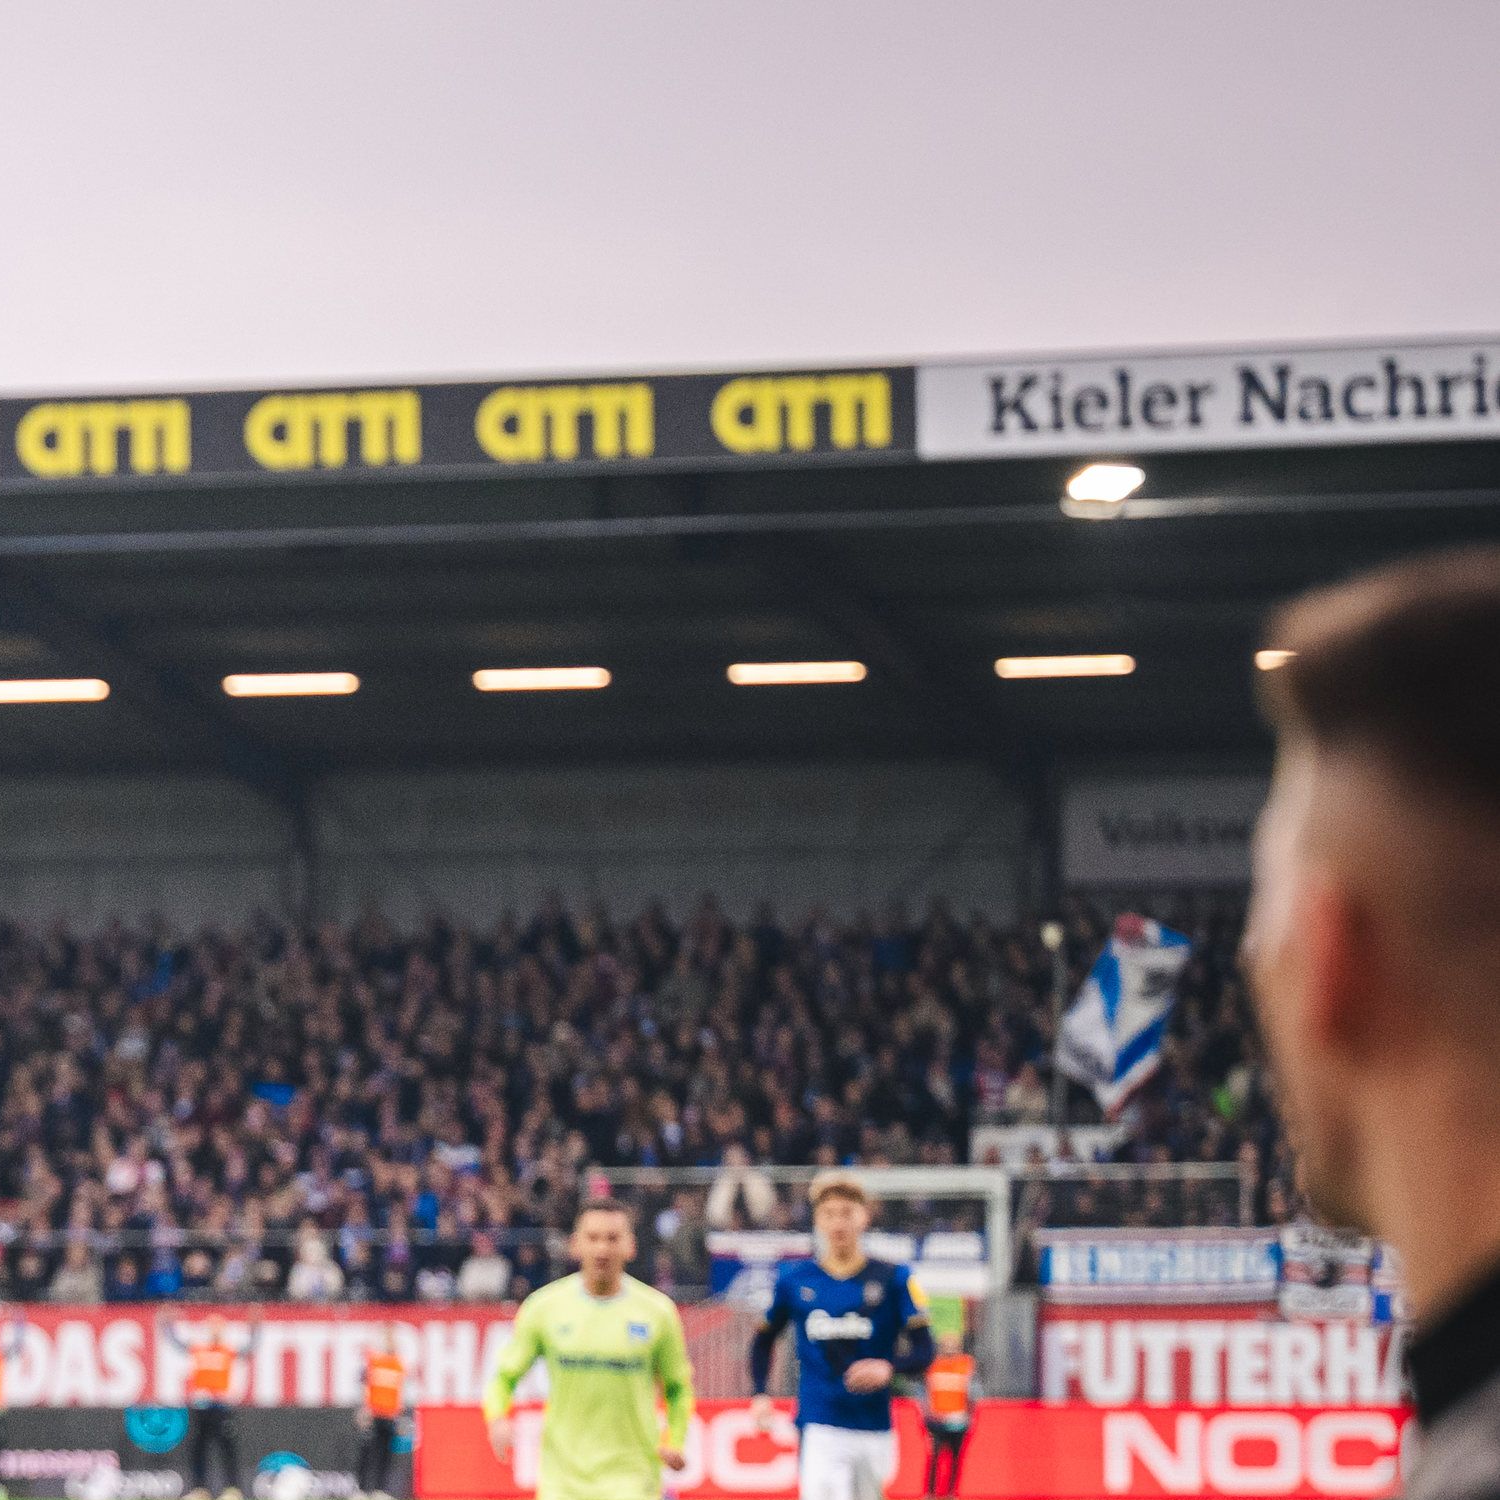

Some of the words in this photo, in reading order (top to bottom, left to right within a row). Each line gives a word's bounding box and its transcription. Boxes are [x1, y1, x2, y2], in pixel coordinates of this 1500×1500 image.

[988, 367, 1212, 435] Kieler
[1238, 352, 1500, 425] Nachri
[0, 1319, 147, 1406] DAS
[1102, 1410, 1418, 1498] NOC
